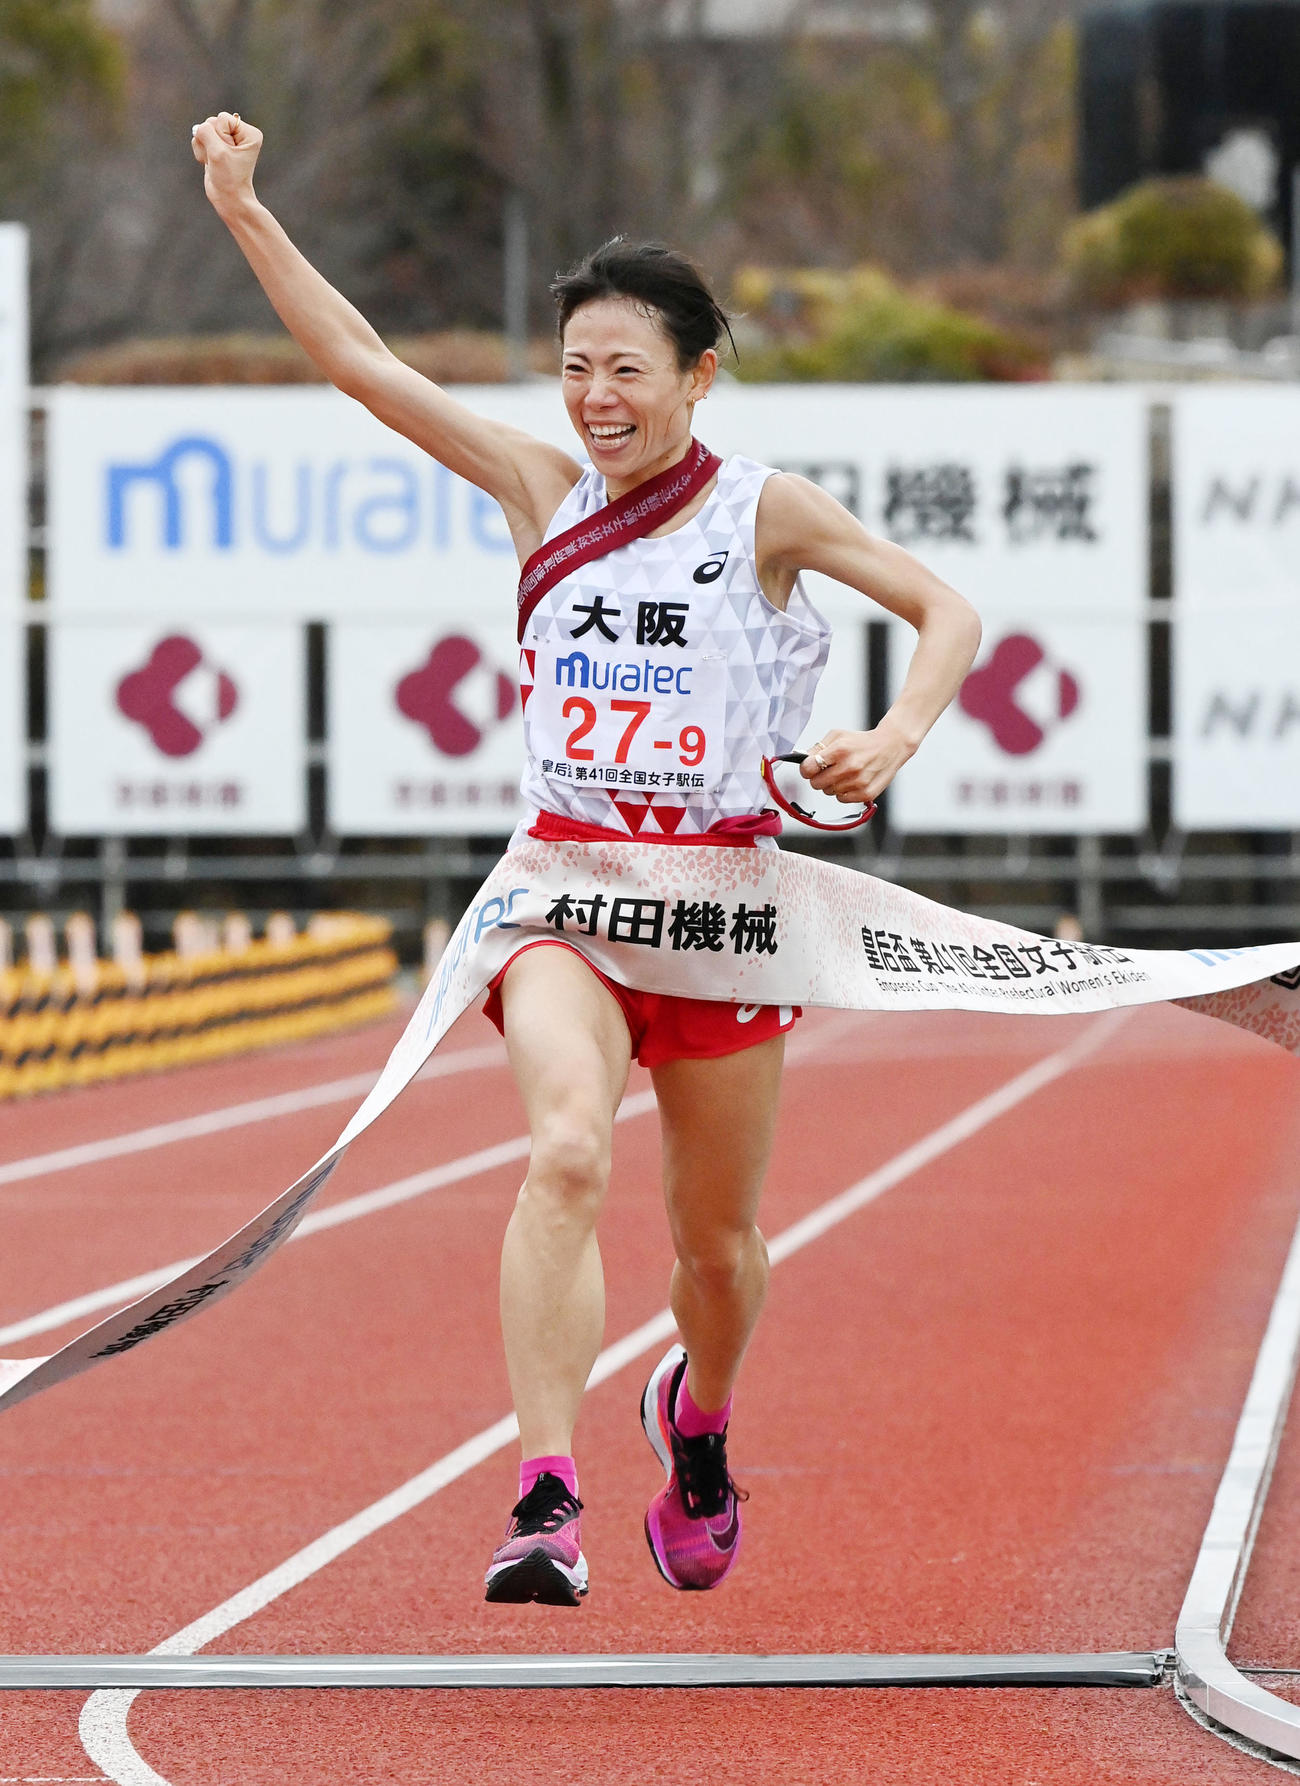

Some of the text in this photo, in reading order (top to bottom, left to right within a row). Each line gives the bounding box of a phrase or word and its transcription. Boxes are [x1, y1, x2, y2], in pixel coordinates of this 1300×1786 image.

[569, 596, 690, 648] 大阪
[555, 651, 693, 695] muratec
[561, 696, 707, 767] 27-9
[545, 894, 779, 955] 村田機械
[1056, 973, 1112, 996] Women's
